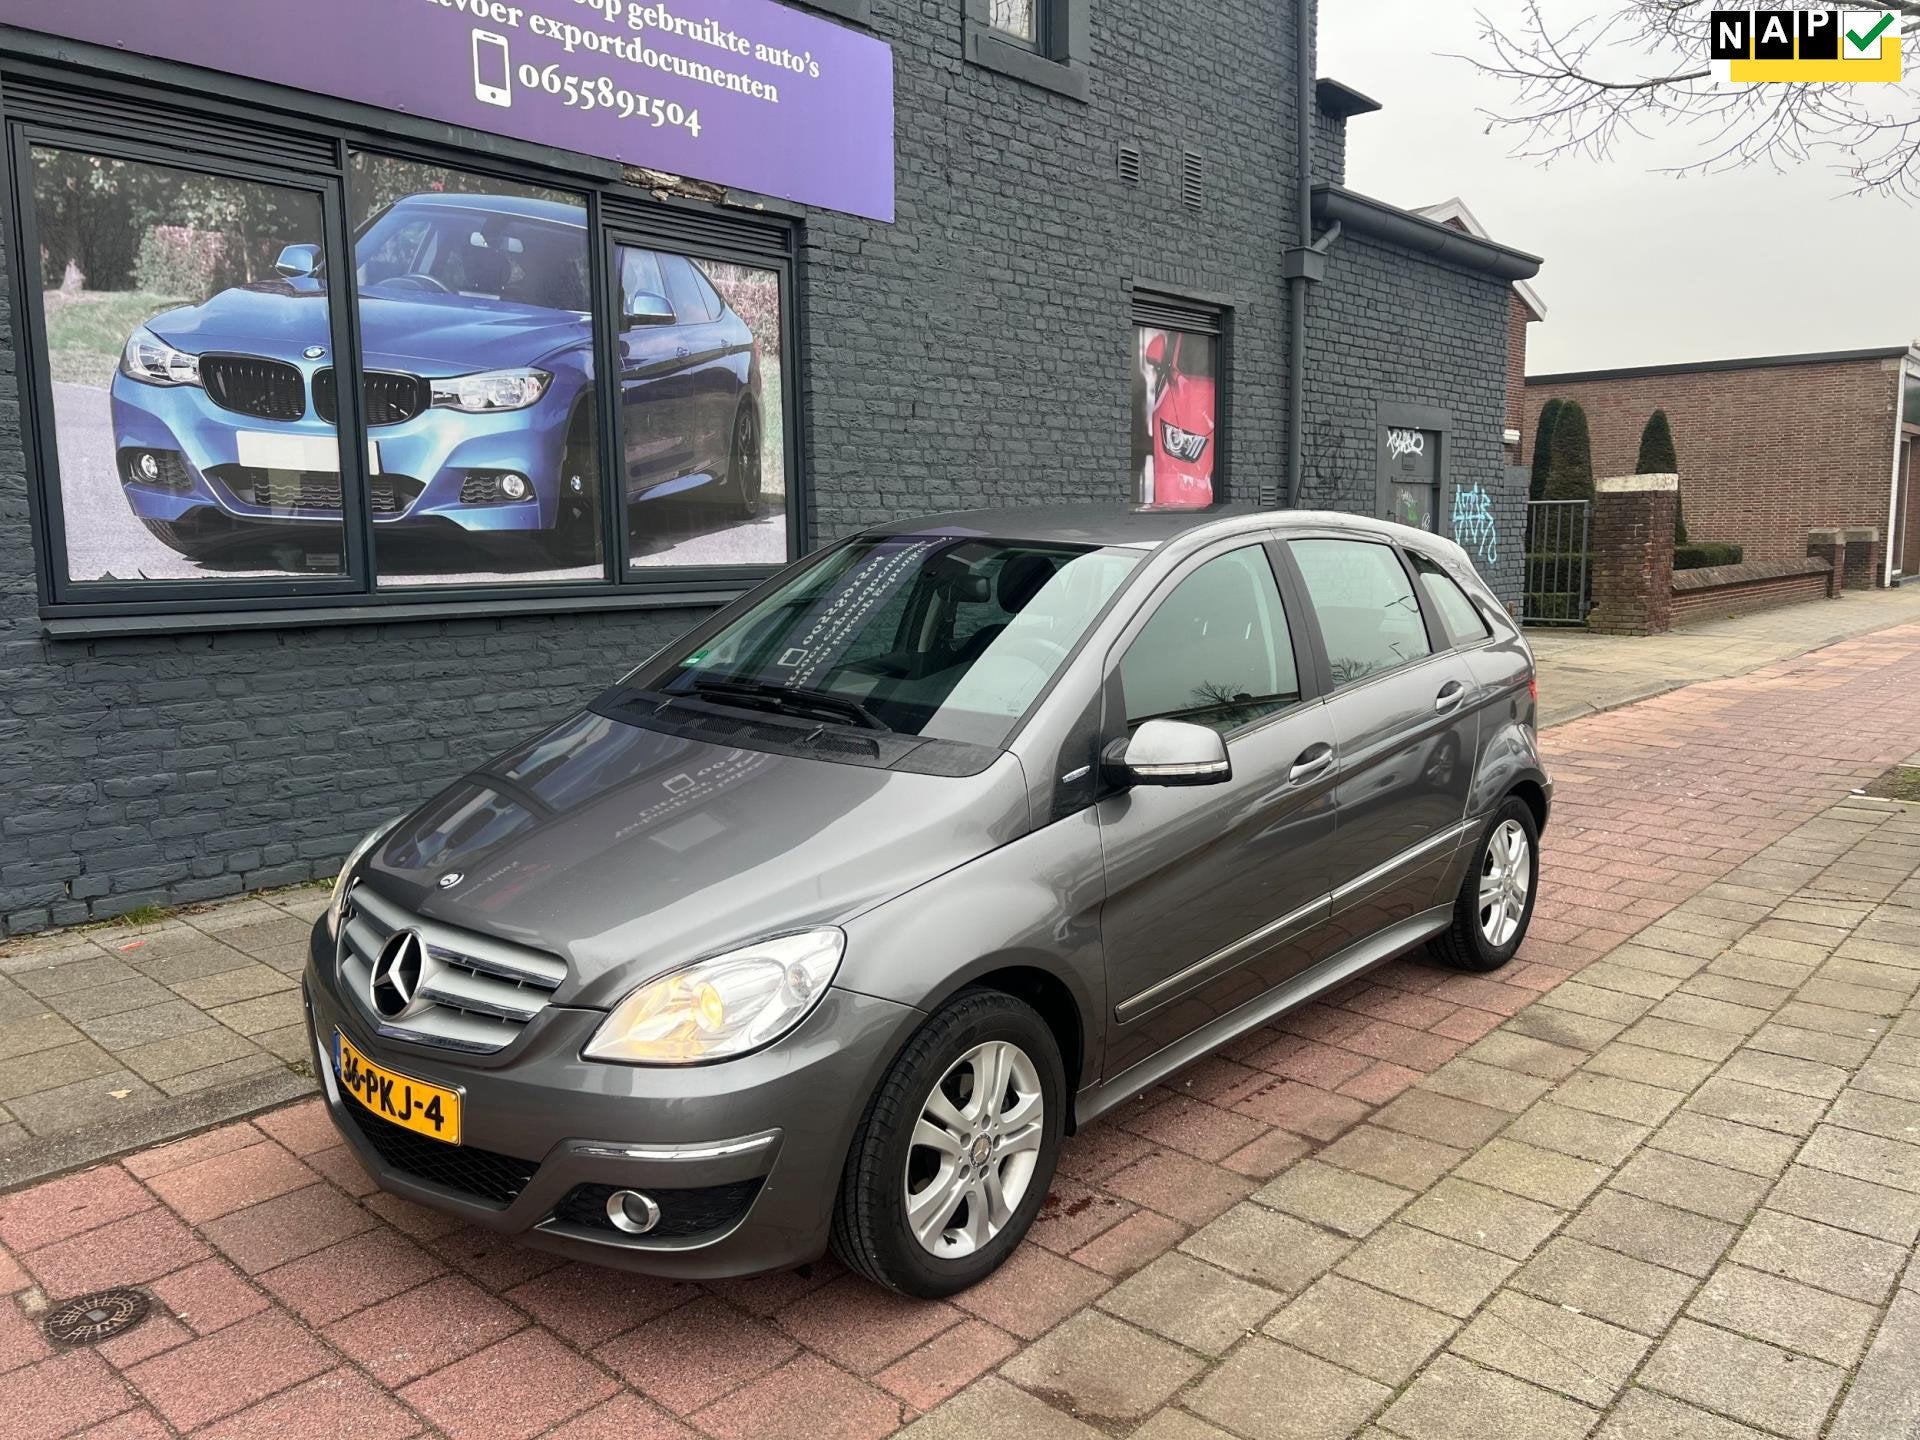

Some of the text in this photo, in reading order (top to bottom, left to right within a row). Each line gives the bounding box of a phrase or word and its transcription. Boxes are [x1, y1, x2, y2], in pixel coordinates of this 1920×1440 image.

[530, 14, 779, 102] exportdocumenten
[628, 2, 750, 56] gebruikte
[754, 42, 820, 78] auto's
[519, 64, 702, 137] 0655891504
[343, 1046, 445, 1132] 36-PKJ-4
